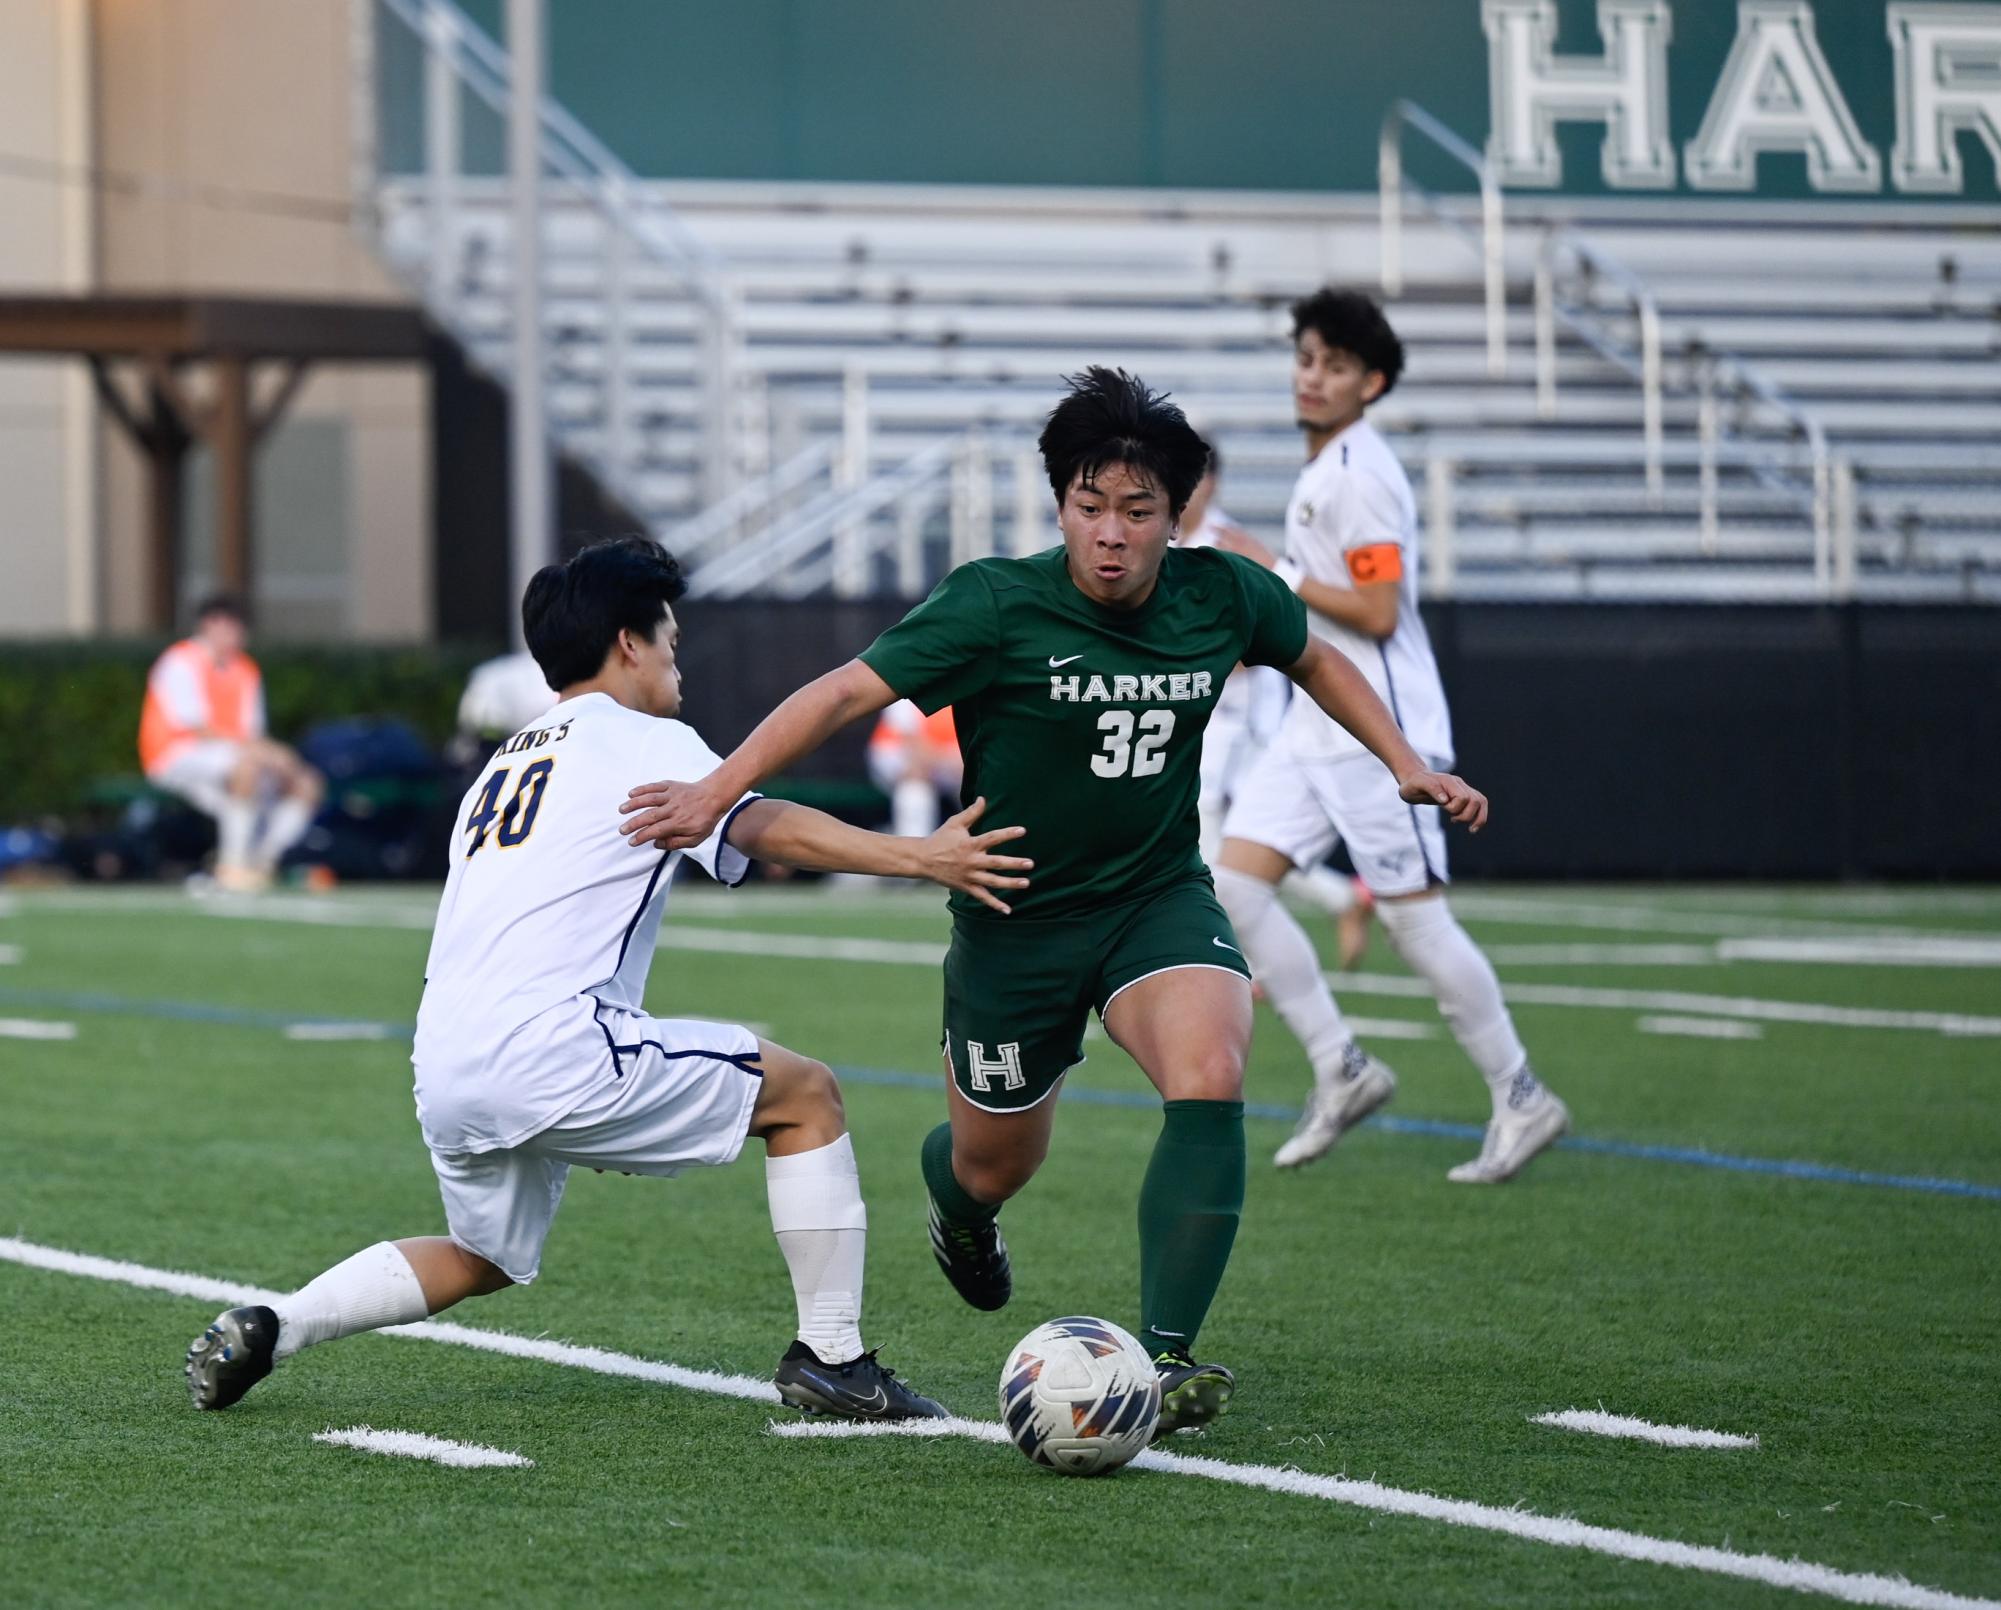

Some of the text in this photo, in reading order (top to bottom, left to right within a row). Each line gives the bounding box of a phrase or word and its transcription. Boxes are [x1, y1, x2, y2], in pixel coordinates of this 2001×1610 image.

[1349, 551, 1376, 581] C
[1050, 671, 1212, 702] HARKER
[1090, 709, 1177, 778] 32
[465, 753, 556, 860] 40
[967, 1040, 1026, 1092] H
